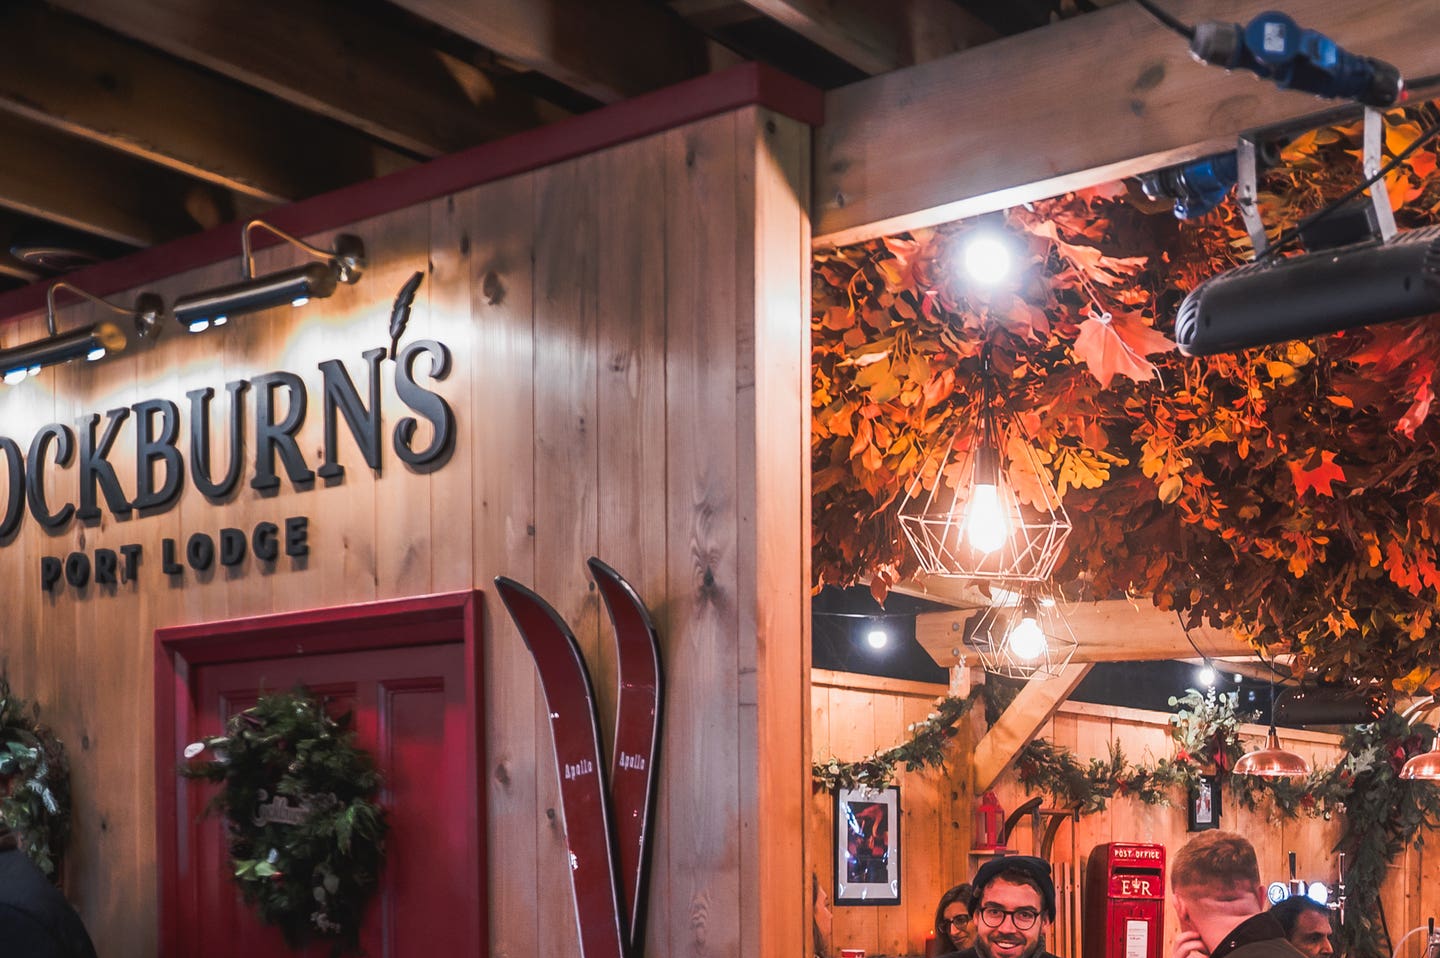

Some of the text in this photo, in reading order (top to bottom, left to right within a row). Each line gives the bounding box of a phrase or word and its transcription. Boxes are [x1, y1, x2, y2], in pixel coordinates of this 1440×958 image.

[41, 516, 309, 591] PORT LODGE
[565, 759, 593, 781] Apollo
[619, 751, 645, 771] Apollo
[1114, 849, 1160, 859] POST OFFICE
